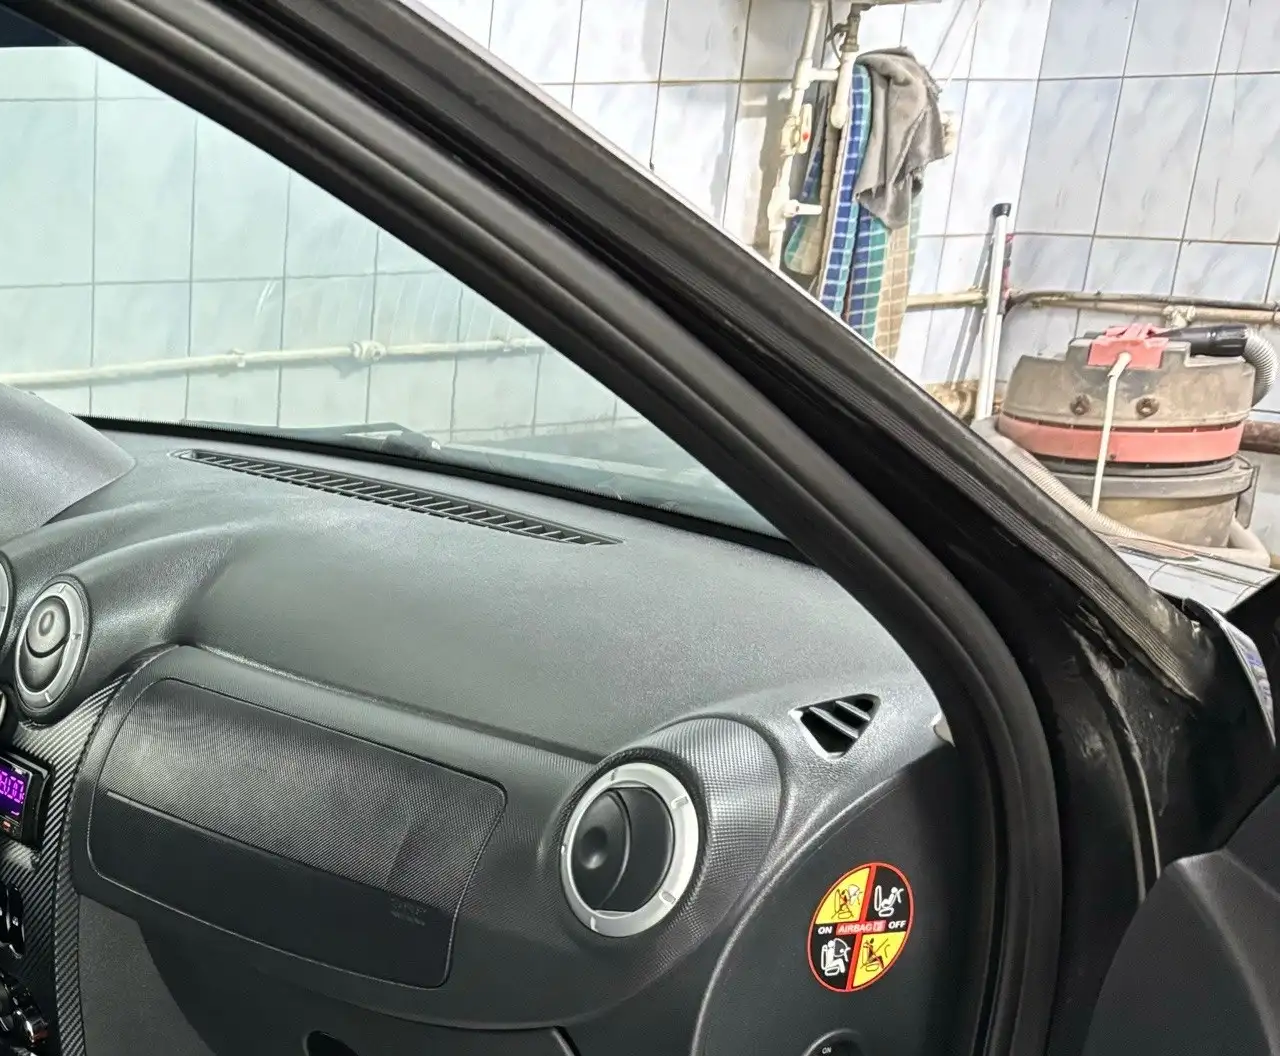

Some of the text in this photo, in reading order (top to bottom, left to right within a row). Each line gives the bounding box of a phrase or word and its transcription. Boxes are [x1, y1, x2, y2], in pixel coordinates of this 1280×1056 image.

[818, 926, 833, 935] ON
[837, 923, 872, 933] AIRBAG
[888, 920, 906, 929] OFF
[822, 1046, 832, 1055] ON
